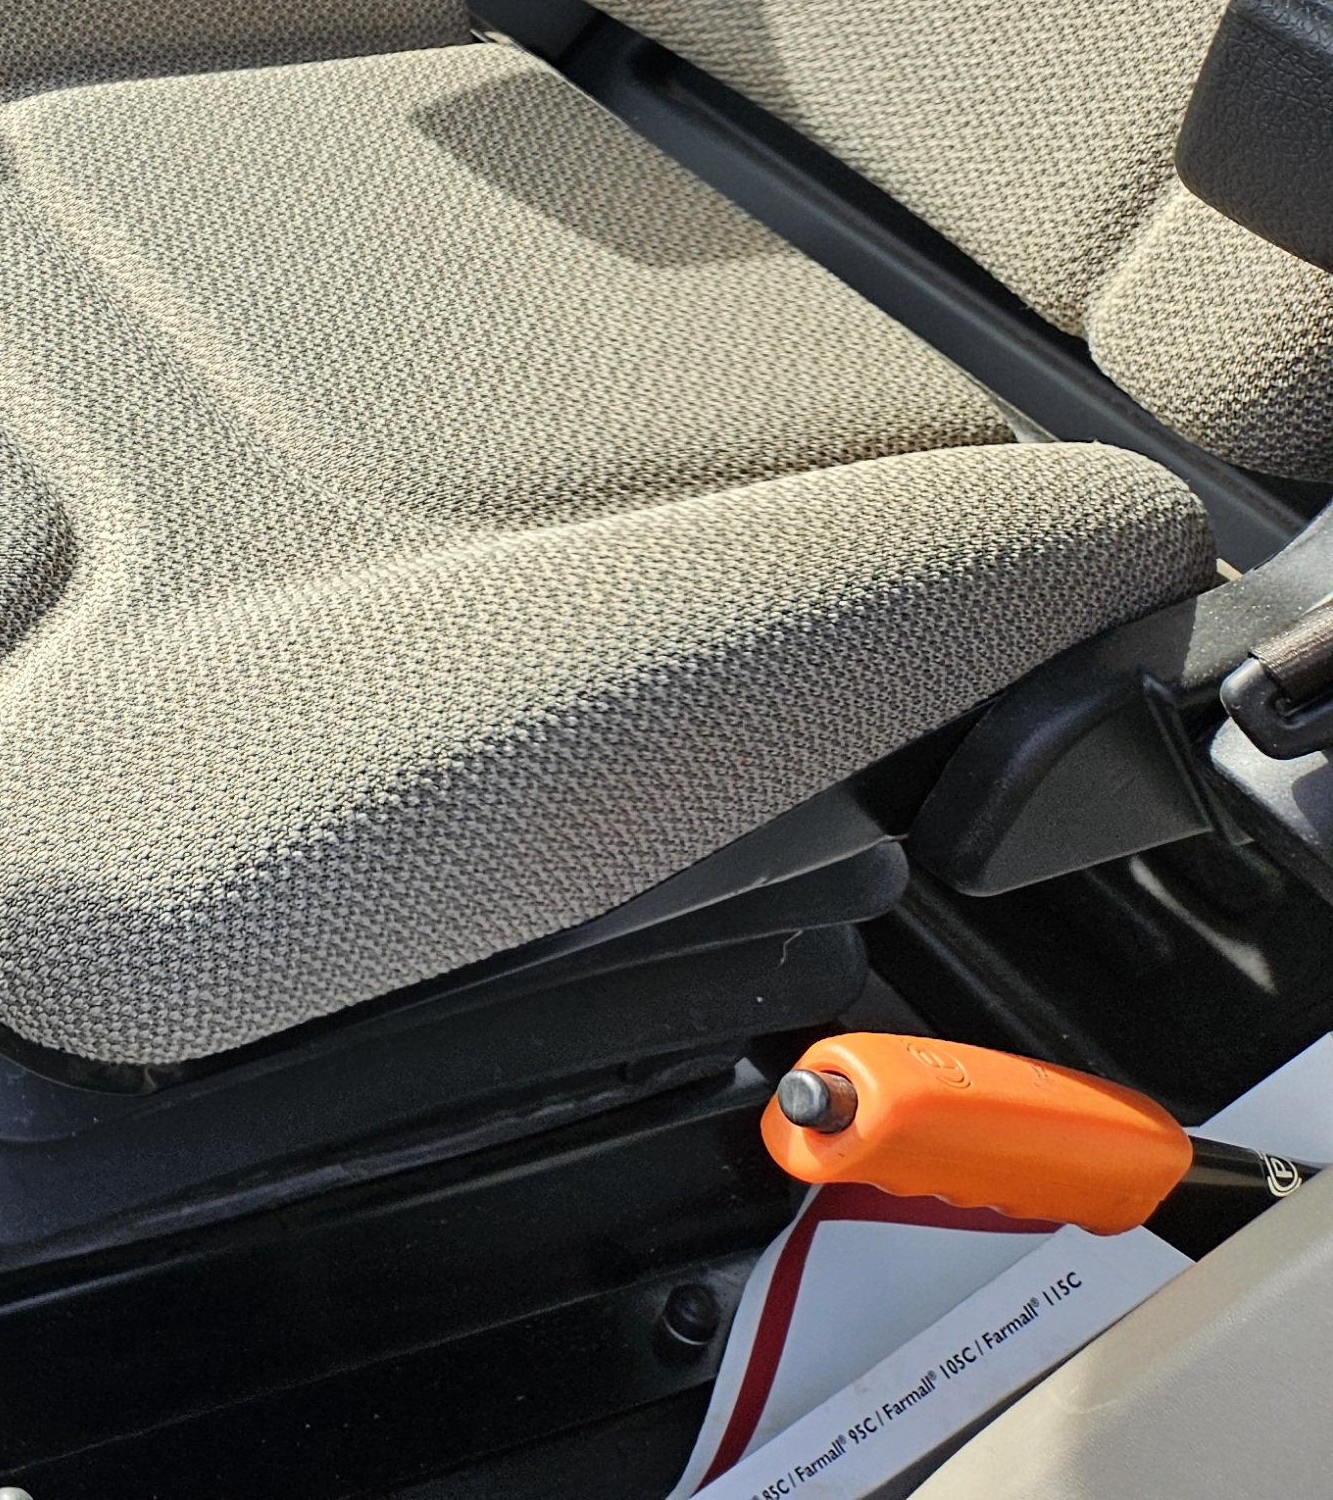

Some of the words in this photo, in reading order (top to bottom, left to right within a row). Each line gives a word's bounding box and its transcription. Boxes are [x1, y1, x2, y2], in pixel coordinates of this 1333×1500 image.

[848, 1417, 877, 1444] 95C
[939, 1346, 977, 1379] 105C
[1042, 1271, 1082, 1306] 115C
